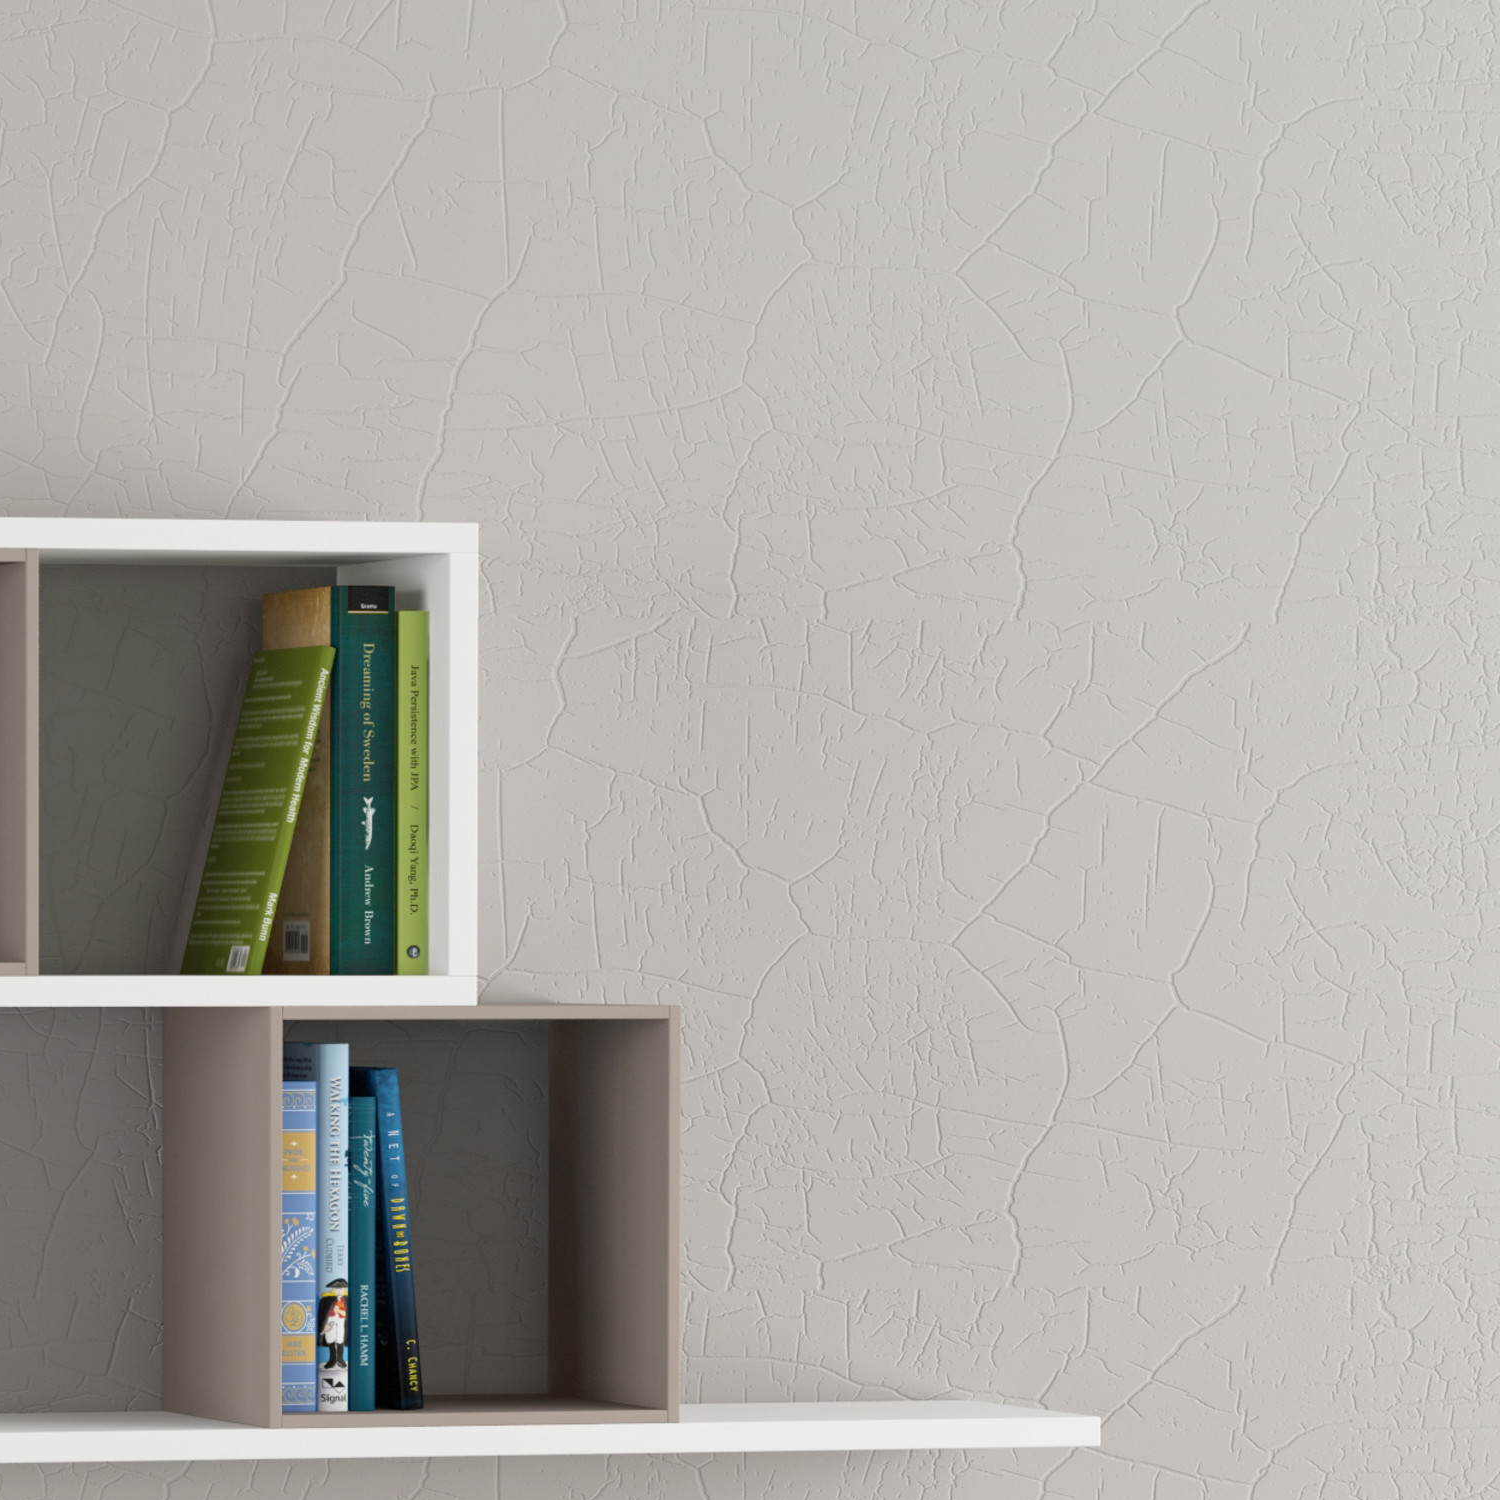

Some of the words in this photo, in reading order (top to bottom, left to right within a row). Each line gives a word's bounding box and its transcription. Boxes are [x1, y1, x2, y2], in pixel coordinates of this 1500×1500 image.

[314, 667, 329, 703] Ancient
[360, 643, 375, 709] Dreaming
[410, 664, 419, 687] Java
[306, 704, 321, 739] Wisdom
[363, 712, 375, 728] of
[410, 690, 419, 745] Persistence
[302, 741, 313, 755] for
[363, 729, 375, 782] Sweden
[410, 748, 419, 769] with
[293, 757, 309, 792] Modern
[410, 772, 419, 791] JPA
[286, 793, 300, 823] Health
[408, 824, 419, 854] Daoqi
[364, 865, 374, 906] Andrew
[408, 857, 419, 885] Yang,
[264, 892, 278, 916] Mark
[410, 888, 419, 915] Ph.D.
[259, 917, 272, 942] Bunn
[364, 910, 374, 945] Brown
[329, 1076, 341, 1138] WALKING
[329, 1142, 340, 1166] THE
[387, 1130, 400, 1161] NET
[390, 1174, 400, 1187] OF
[329, 1168, 341, 1232] HEXAGON
[390, 1198, 407, 1230] DAWN
[360, 1284, 369, 1323] RACHEL
[360, 1325, 369, 1333] L.
[360, 1335, 369, 1367] HAMM
[406, 1339, 417, 1351] C.
[407, 1356, 419, 1392] CHANCY
[320, 1394, 347, 1404] Signal
